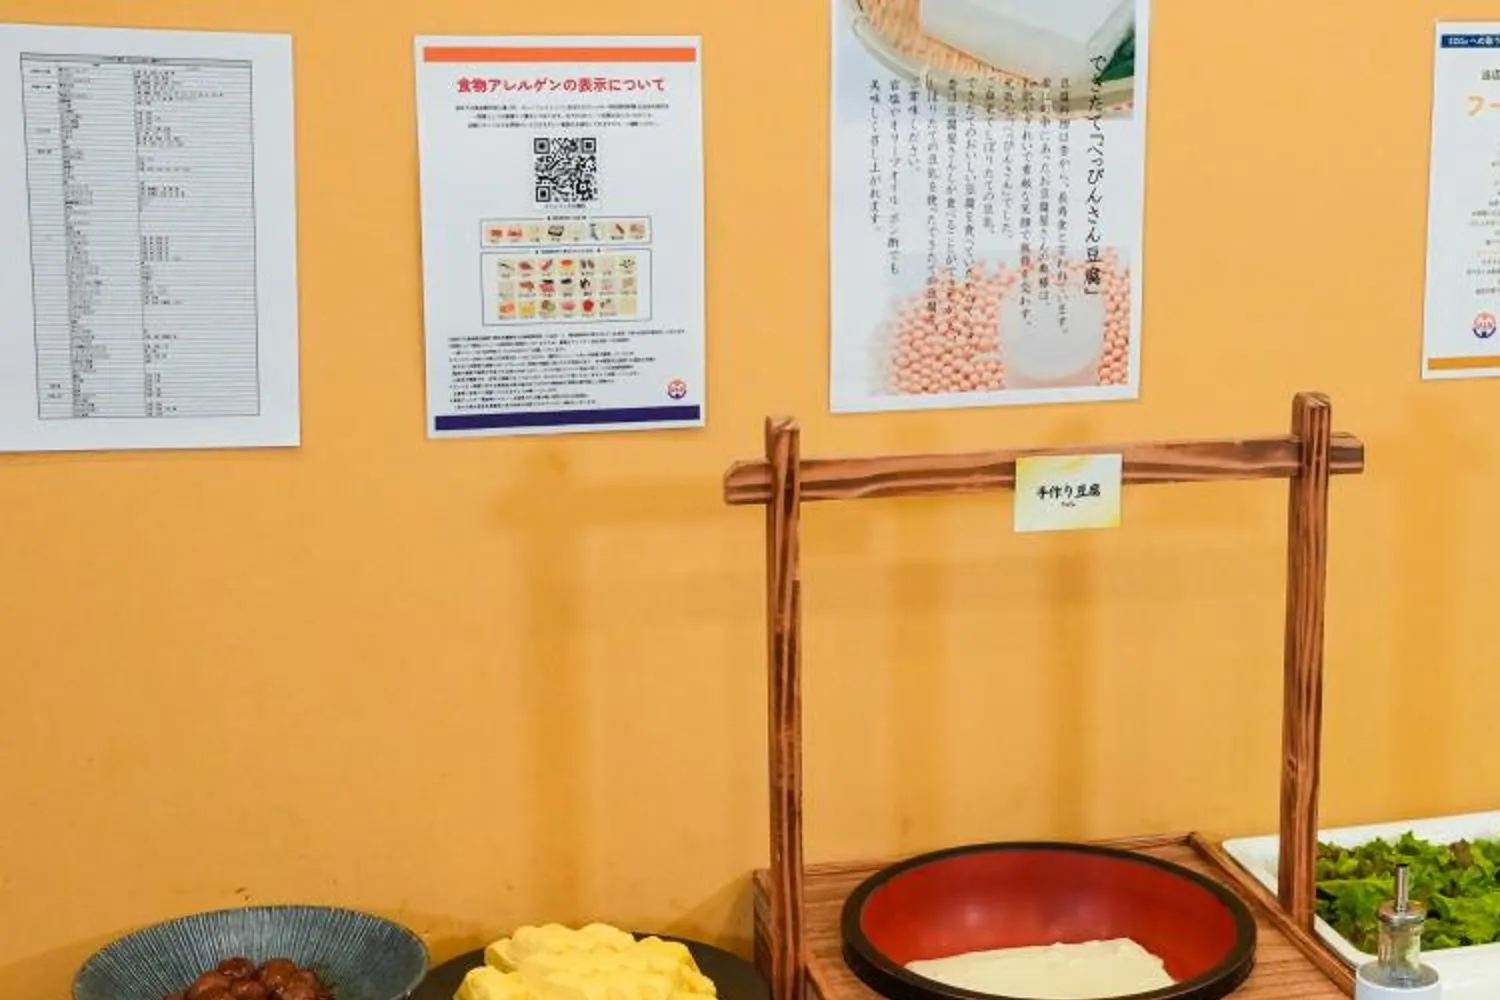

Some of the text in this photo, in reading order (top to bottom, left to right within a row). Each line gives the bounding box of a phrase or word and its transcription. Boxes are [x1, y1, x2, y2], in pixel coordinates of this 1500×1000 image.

[456, 76, 667, 93] 食物アレルゲンの表示について
[1036, 482, 1101, 500] 手作り豆腐
